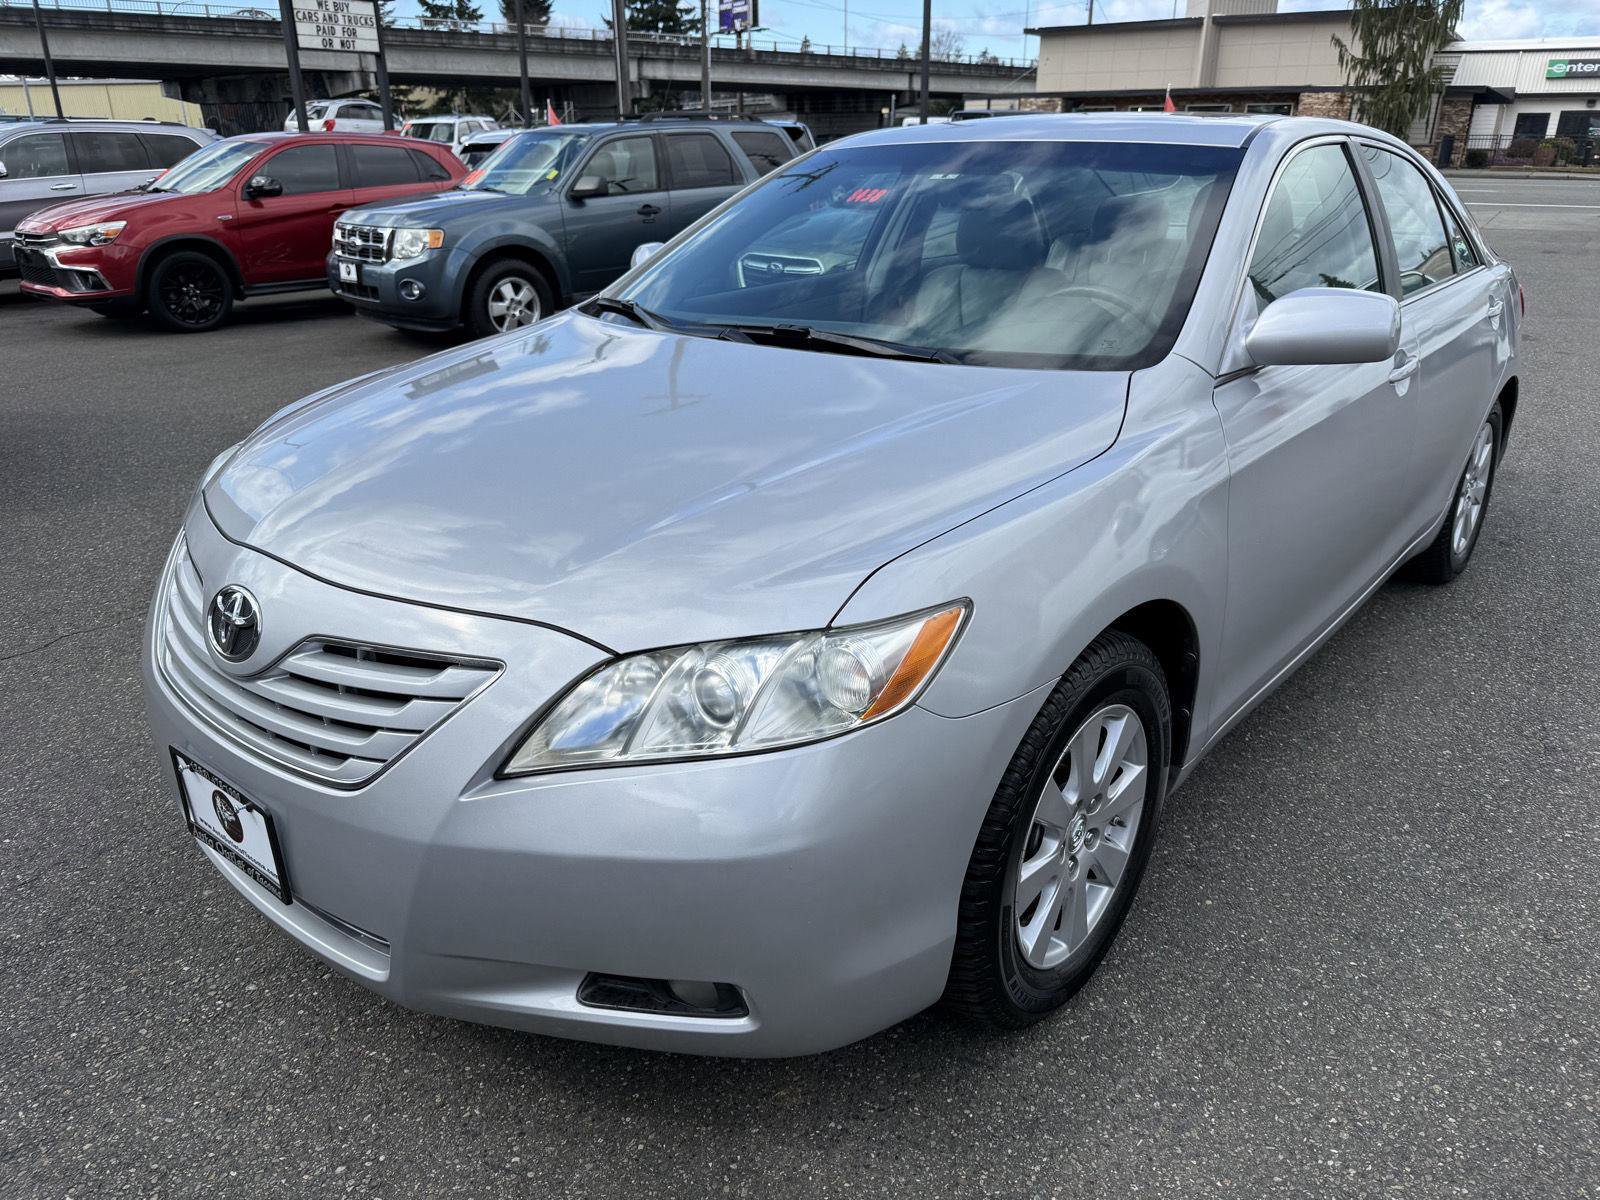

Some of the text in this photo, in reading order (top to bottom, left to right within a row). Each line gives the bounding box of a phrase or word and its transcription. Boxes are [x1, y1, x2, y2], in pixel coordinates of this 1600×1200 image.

[317, 0, 350, 12] WE BUY
[295, 10, 374, 27] CARS AND TRUCKS
[316, 25, 358, 38] PAID FOR
[321, 39, 356, 49] OR NOT
